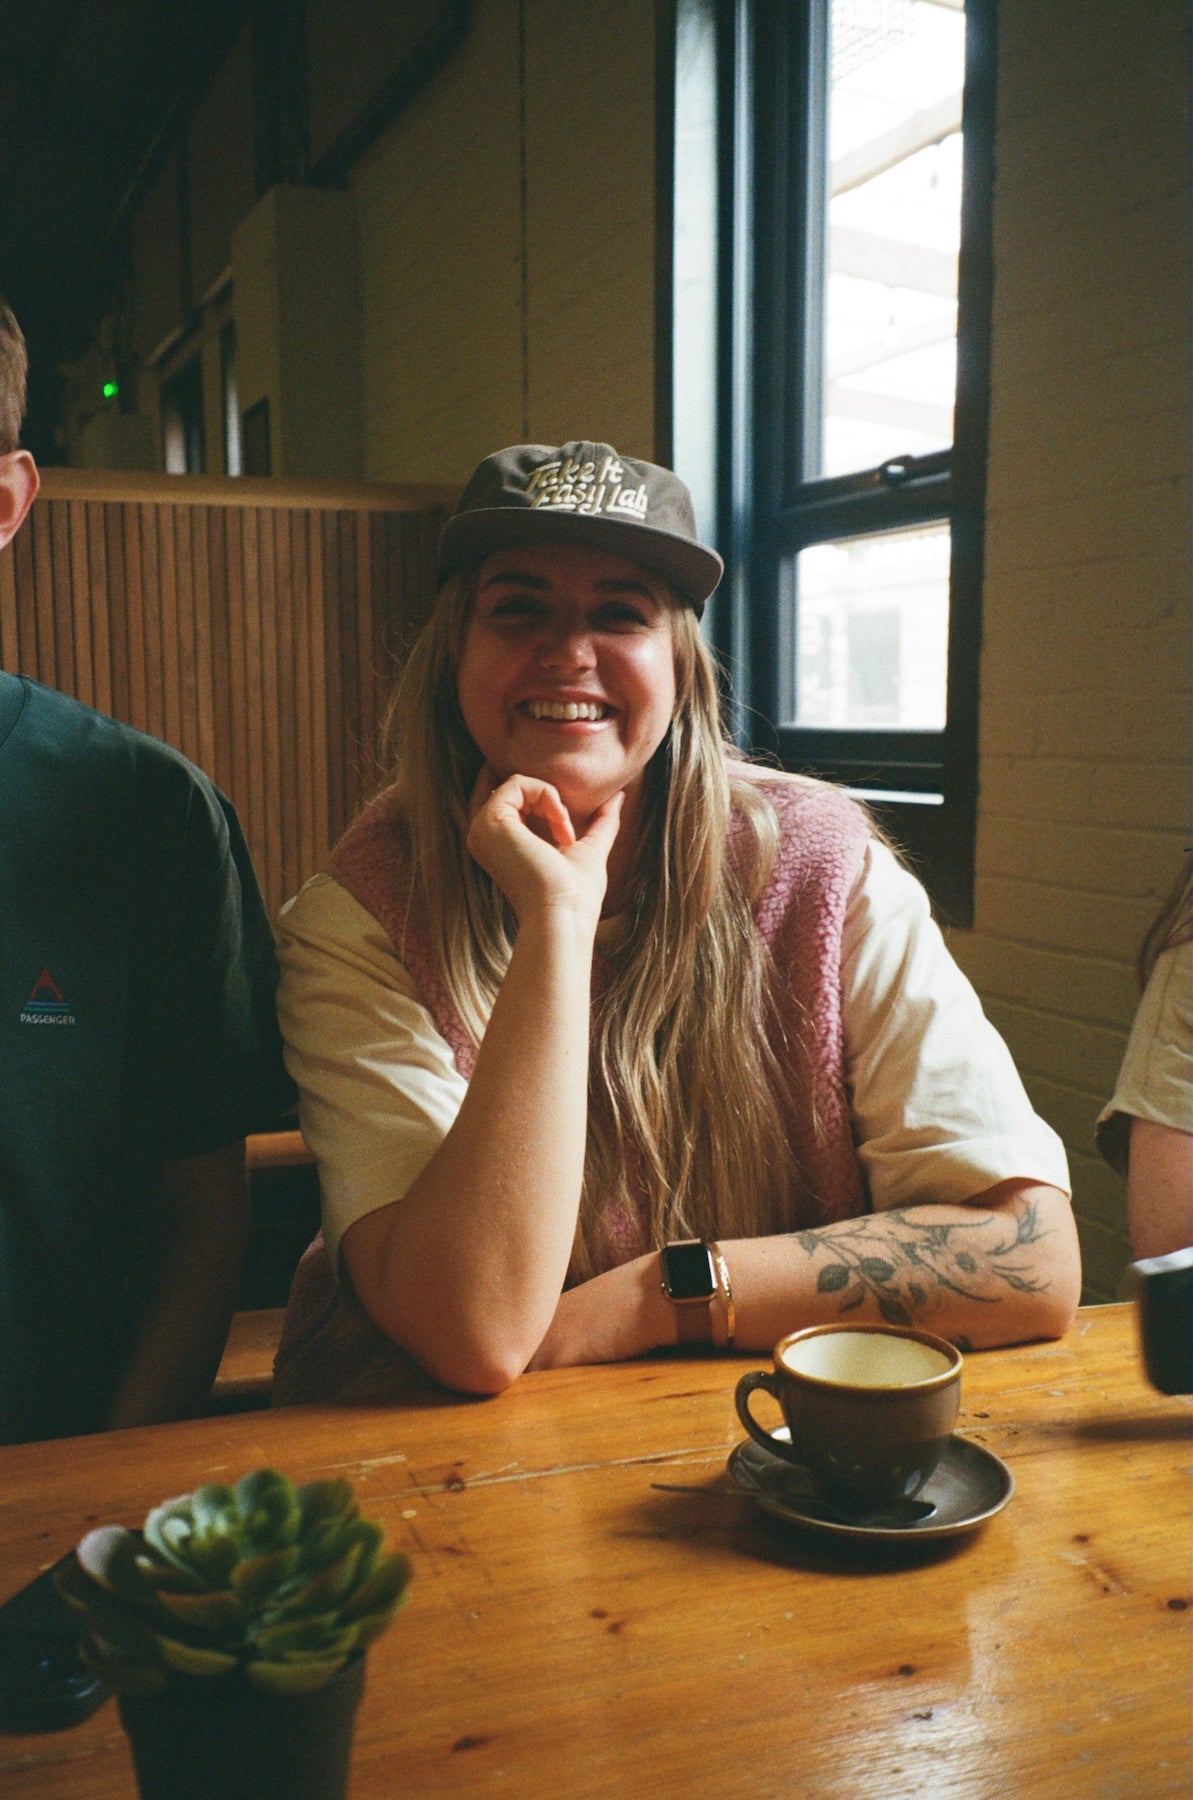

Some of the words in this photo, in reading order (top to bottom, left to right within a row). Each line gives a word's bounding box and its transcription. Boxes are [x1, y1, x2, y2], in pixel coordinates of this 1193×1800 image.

[525, 456, 595, 494] Take
[600, 456, 624, 483] It
[530, 483, 606, 515] Easy
[606, 484, 649, 520] Lab
[20, 1013, 76, 1025] PASSENGER
